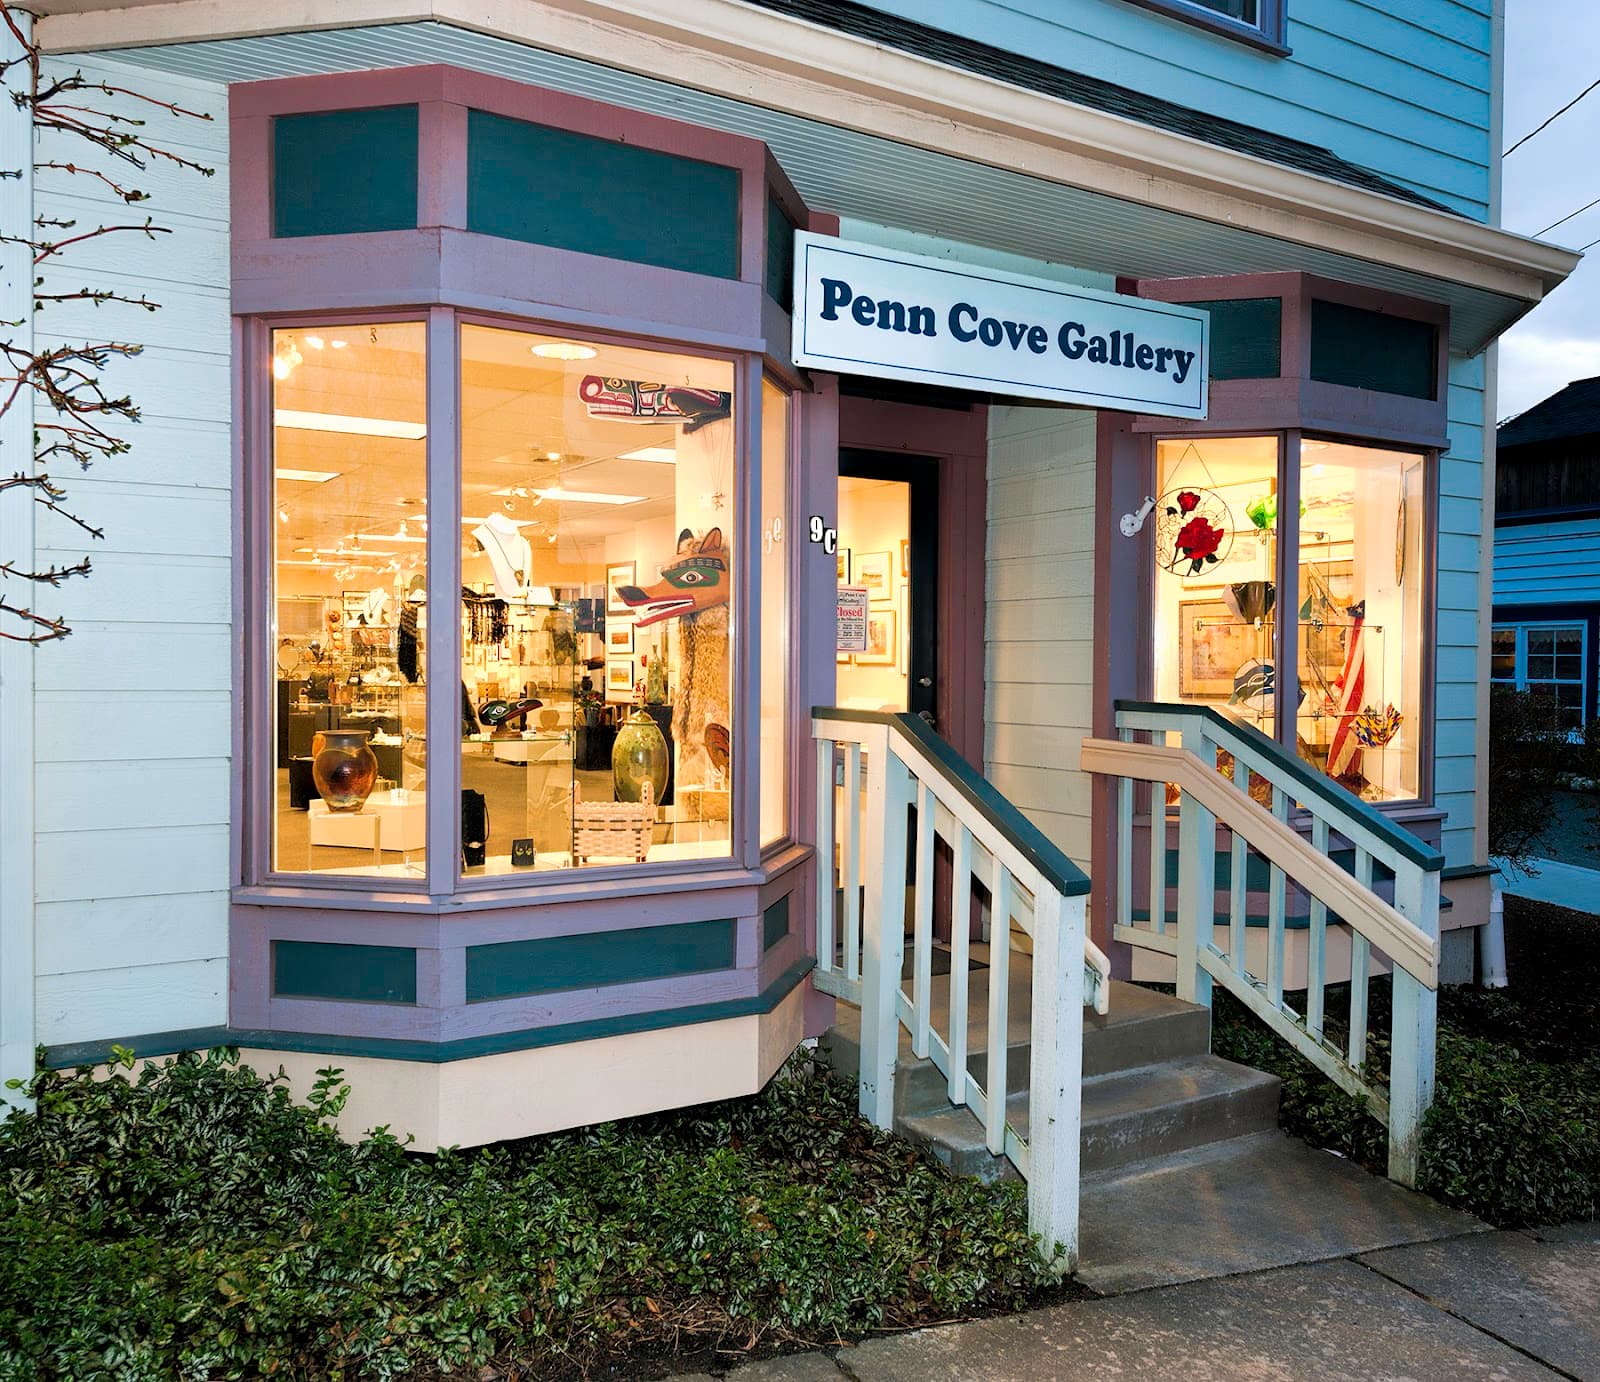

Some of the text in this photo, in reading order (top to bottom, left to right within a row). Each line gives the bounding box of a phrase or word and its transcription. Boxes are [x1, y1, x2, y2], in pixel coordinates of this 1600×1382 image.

[819, 277, 1196, 384] Penn Cove Gallery
